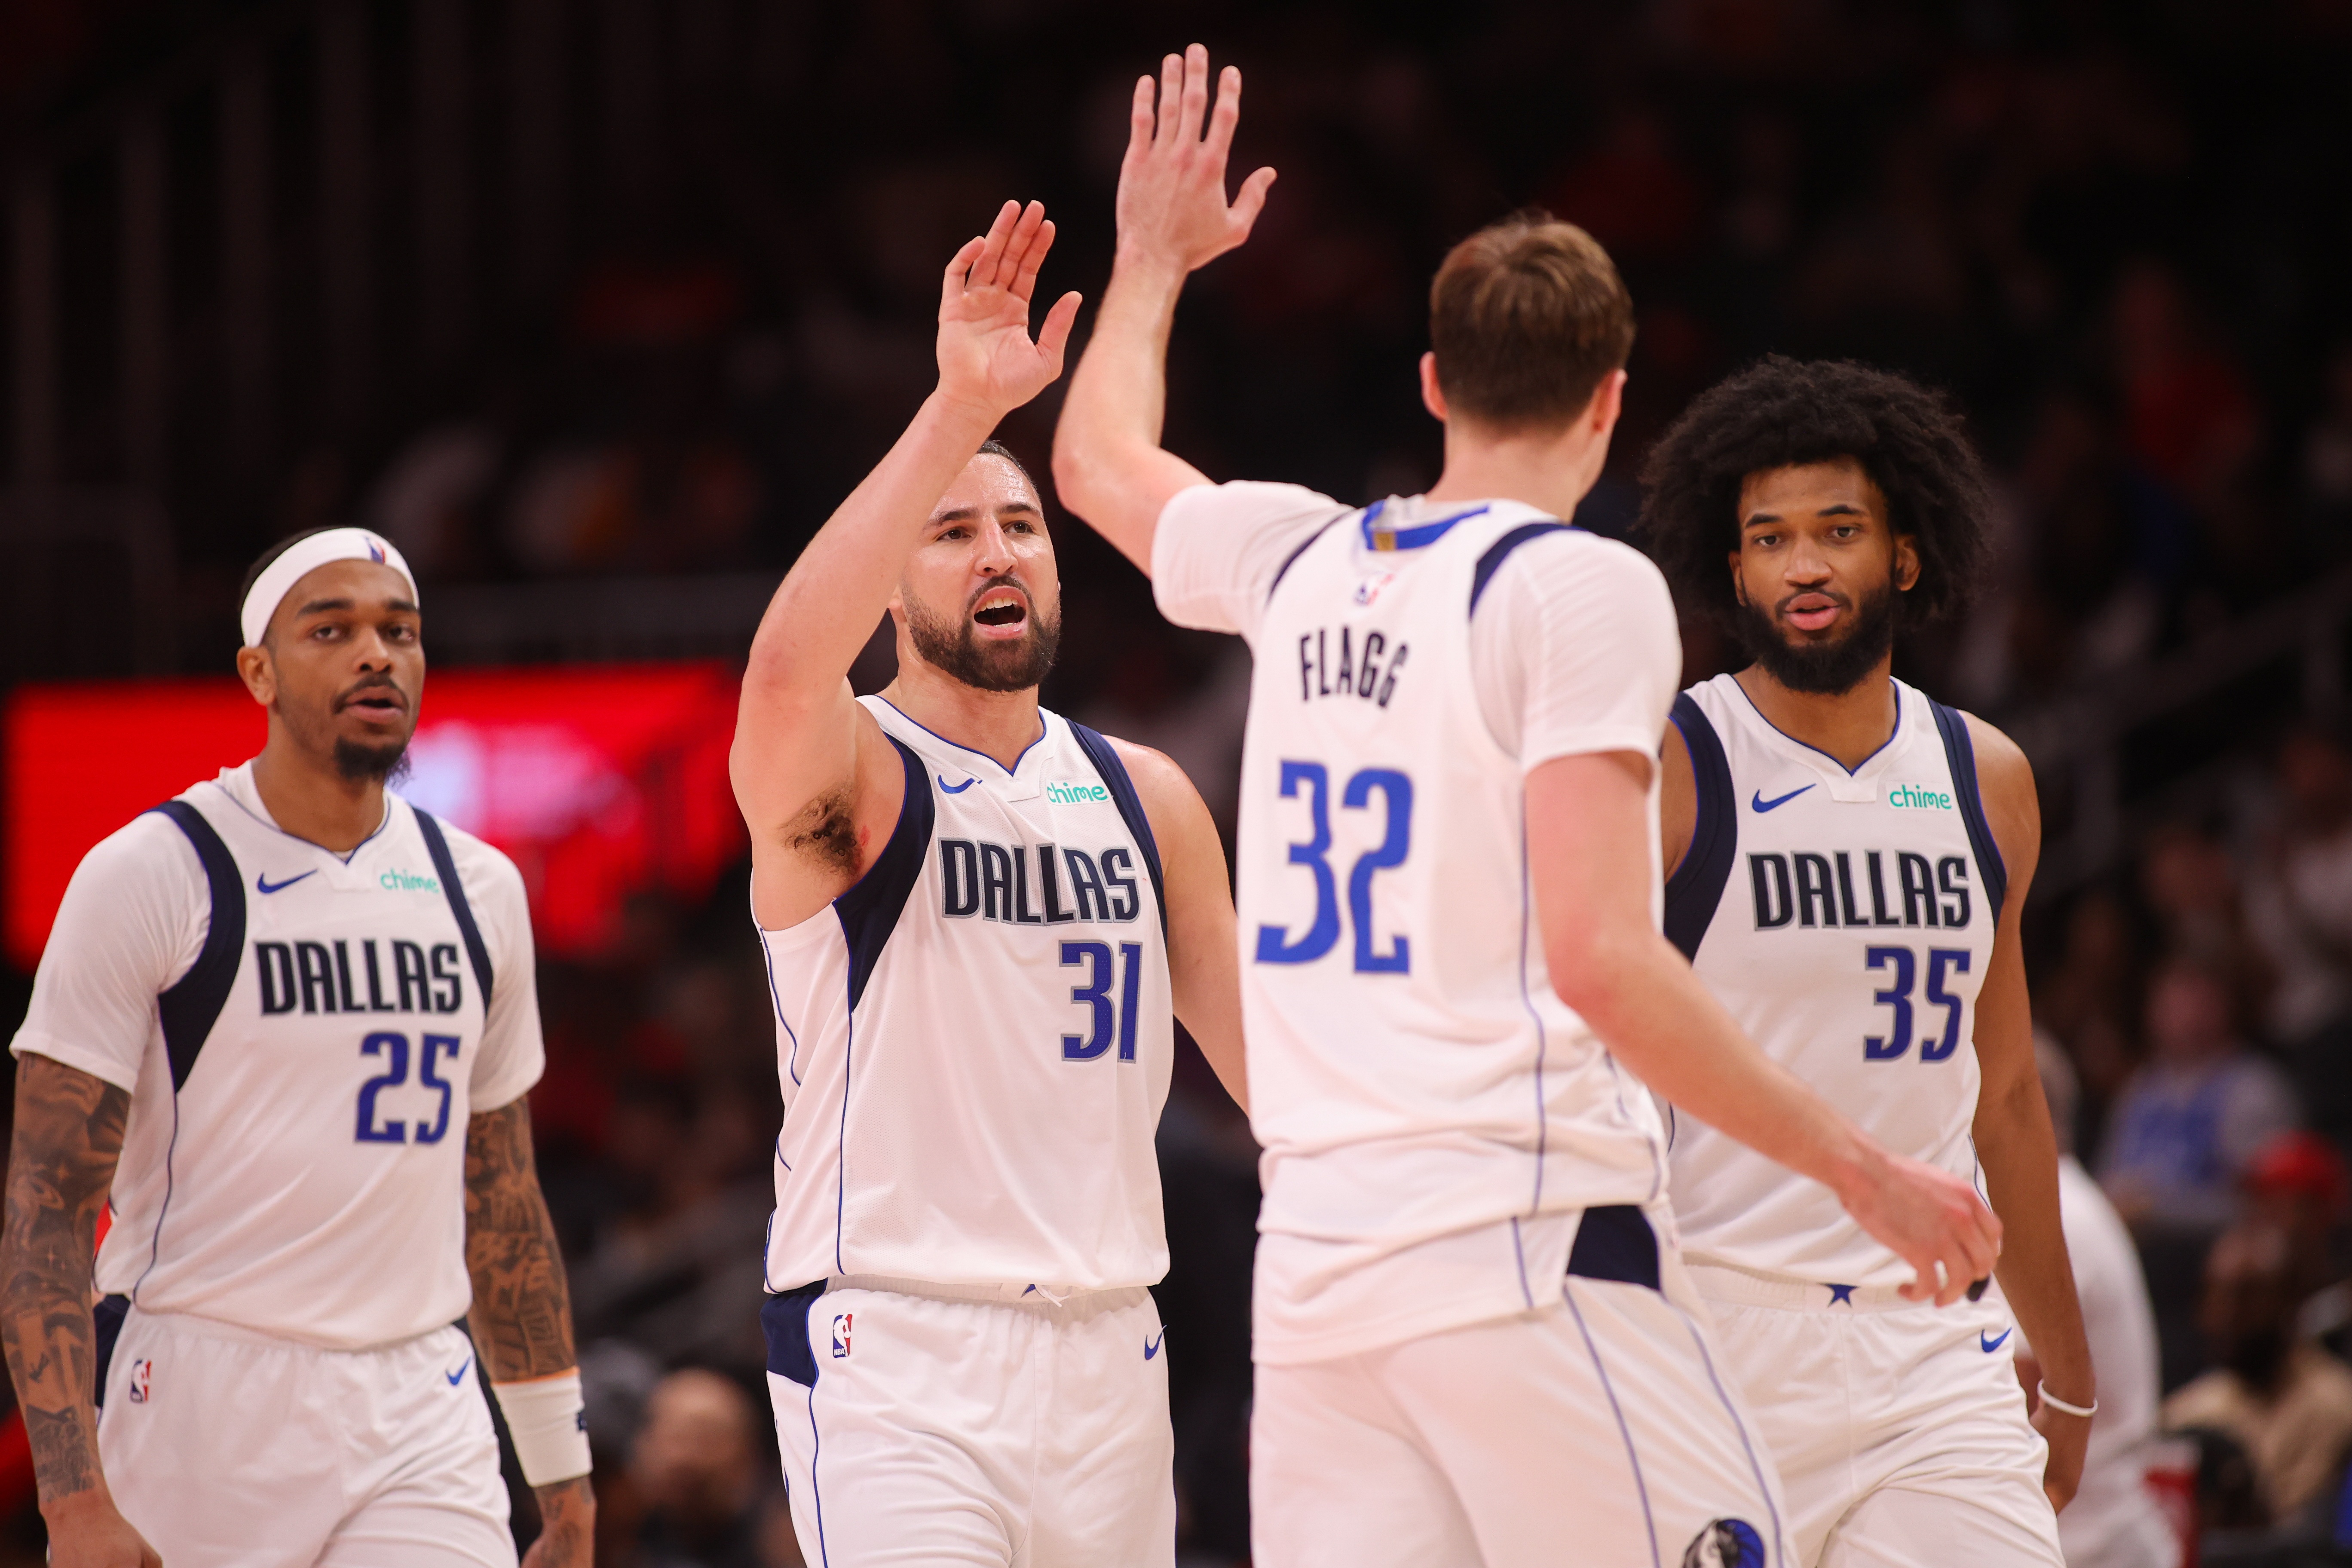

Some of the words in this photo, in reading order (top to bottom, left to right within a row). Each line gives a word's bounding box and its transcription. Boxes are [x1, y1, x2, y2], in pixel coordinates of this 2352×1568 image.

[1300, 626, 1409, 708] FLAGG
[1047, 782, 1107, 803] chime
[1890, 784, 1952, 809] chime
[381, 868, 439, 893] chime
[938, 837, 1141, 925] DALLAS
[1254, 758, 1414, 975] 32
[1746, 850, 1972, 931] DALLAS
[254, 939, 462, 1016] DALLAS
[1059, 940, 1143, 1063] 31
[1864, 945, 1972, 1063] 35
[354, 1032, 461, 1144] 25
[834, 1348, 845, 1356] NBA
